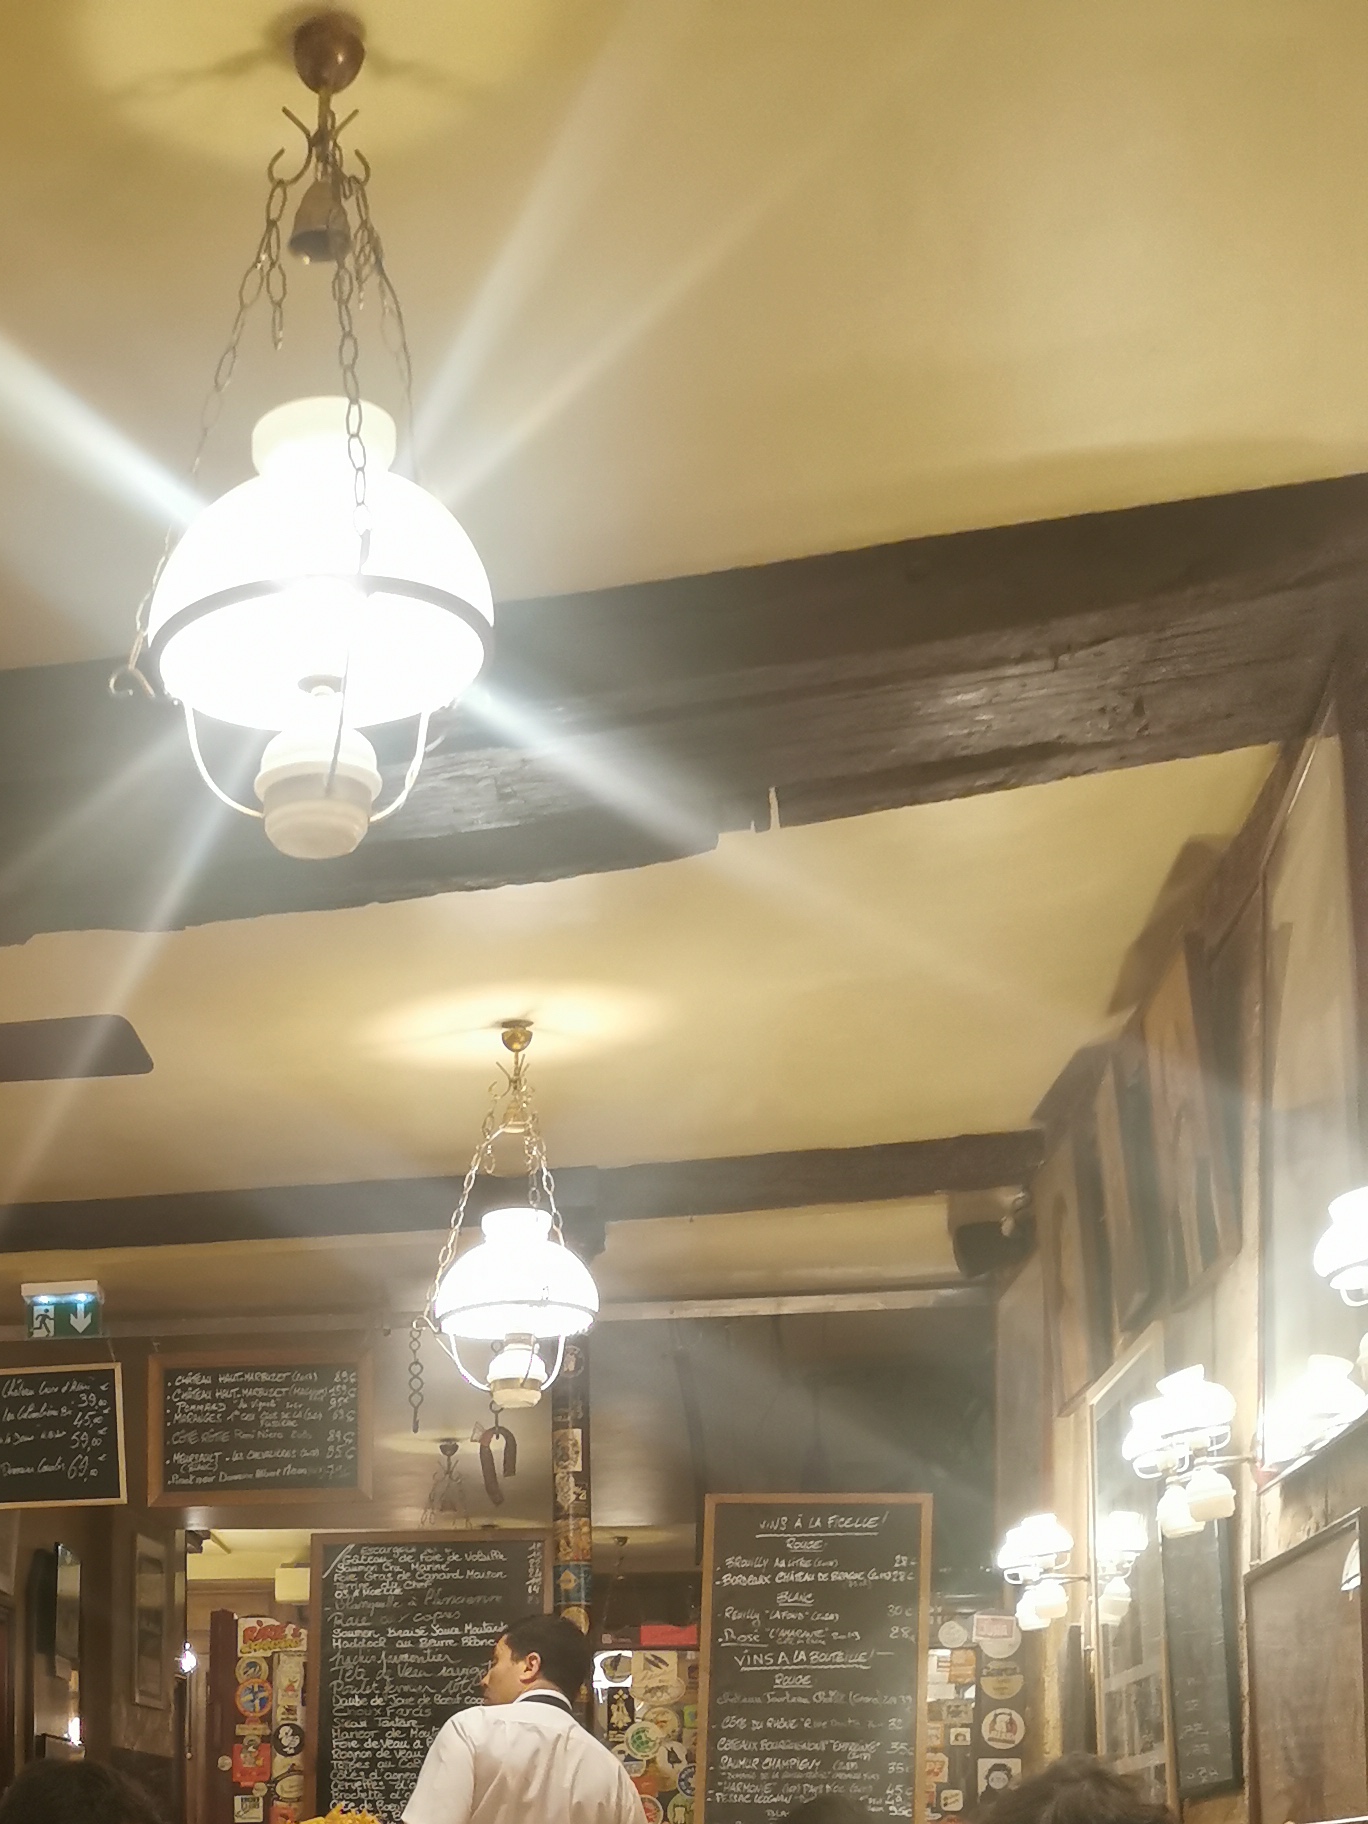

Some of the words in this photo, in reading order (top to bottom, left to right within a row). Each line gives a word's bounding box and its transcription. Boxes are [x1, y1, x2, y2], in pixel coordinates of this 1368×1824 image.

[808, 1517, 822, 1529] LA
[398, 1554, 415, 1562] de
[397, 1570, 411, 1580] de
[332, 1628, 380, 1638] Saumon
[332, 1638, 387, 1649] Haddock
[396, 1640, 416, 1648] au
[734, 1650, 774, 1667] VINS
[793, 1650, 807, 1664] LA
[370, 1694, 385, 1705] de
[417, 1695, 431, 1705] de
[385, 1727, 407, 1738] de
[363, 1738, 380, 1749] de
[375, 1748, 392, 1758] de
